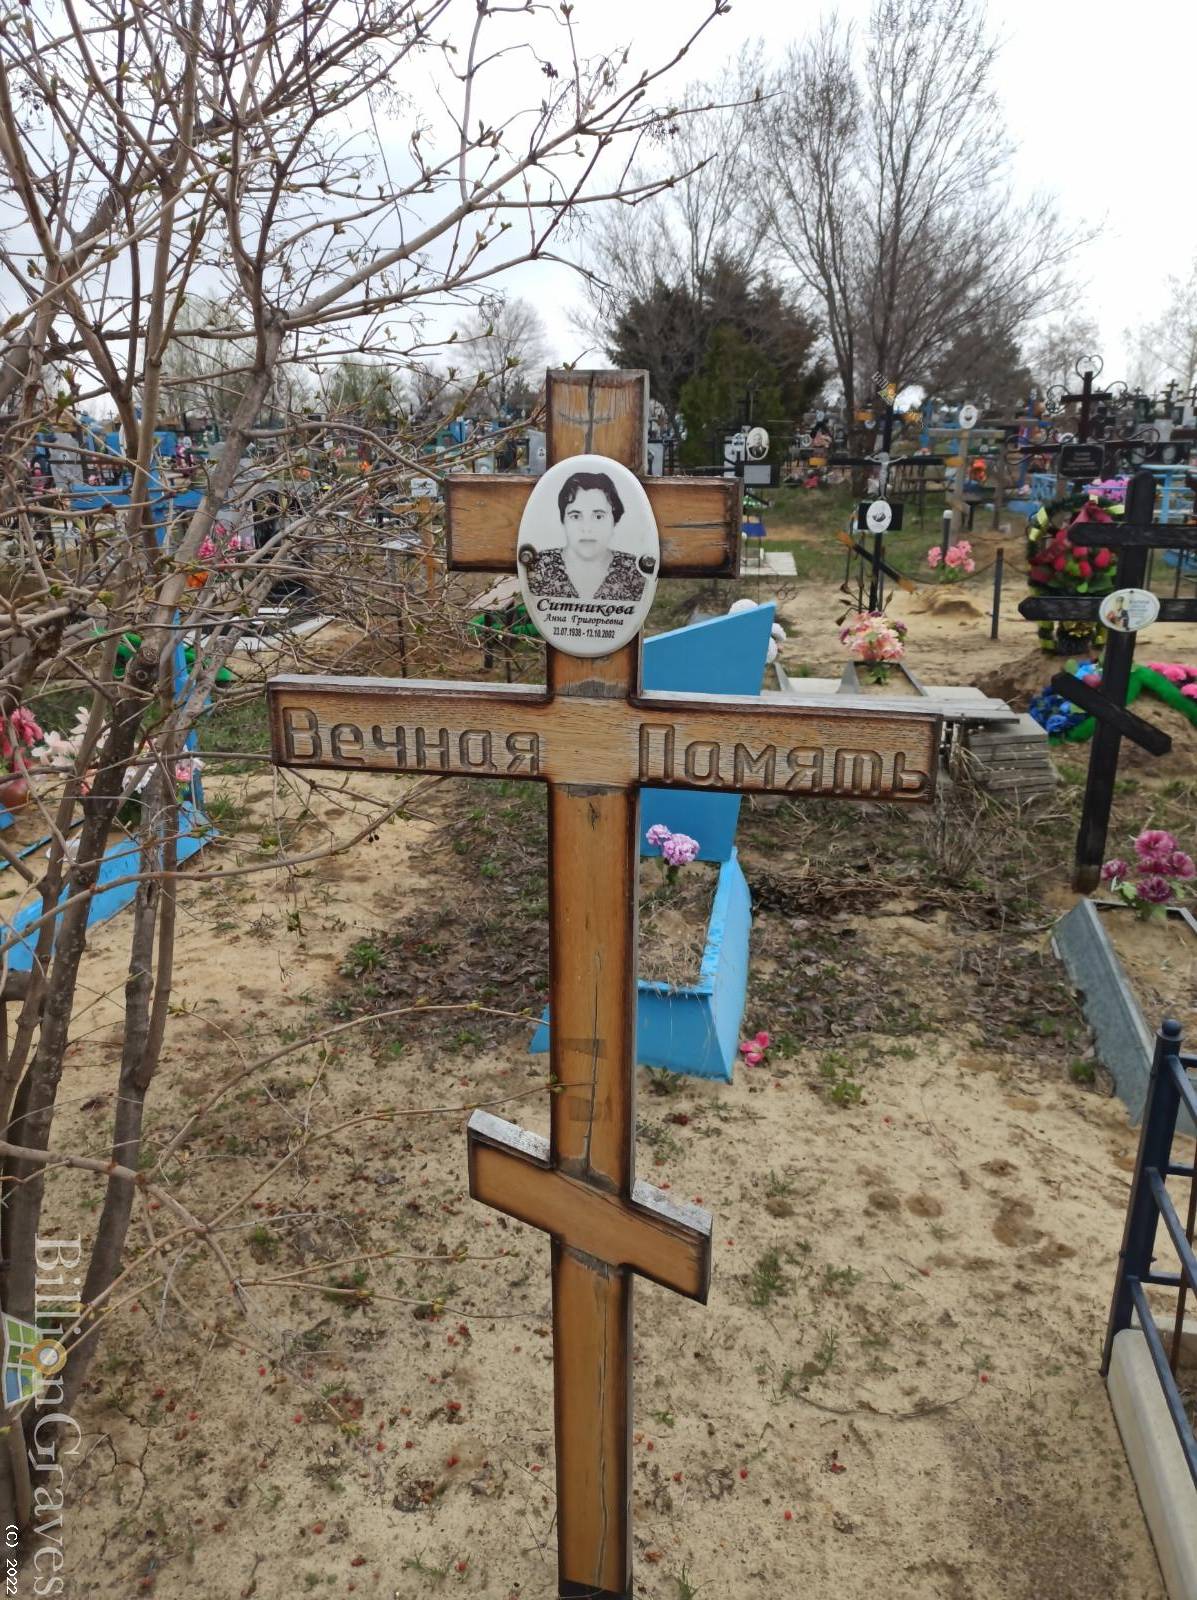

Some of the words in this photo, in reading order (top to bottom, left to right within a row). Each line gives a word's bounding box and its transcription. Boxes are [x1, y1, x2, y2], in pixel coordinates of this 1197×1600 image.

[537, 598, 636, 617] Ситникова
[544, 613, 567, 623] Анна
[571, 614, 624, 627] Григорьевна
[281, 706, 541, 776] Вечная
[638, 722, 930, 798] Память
